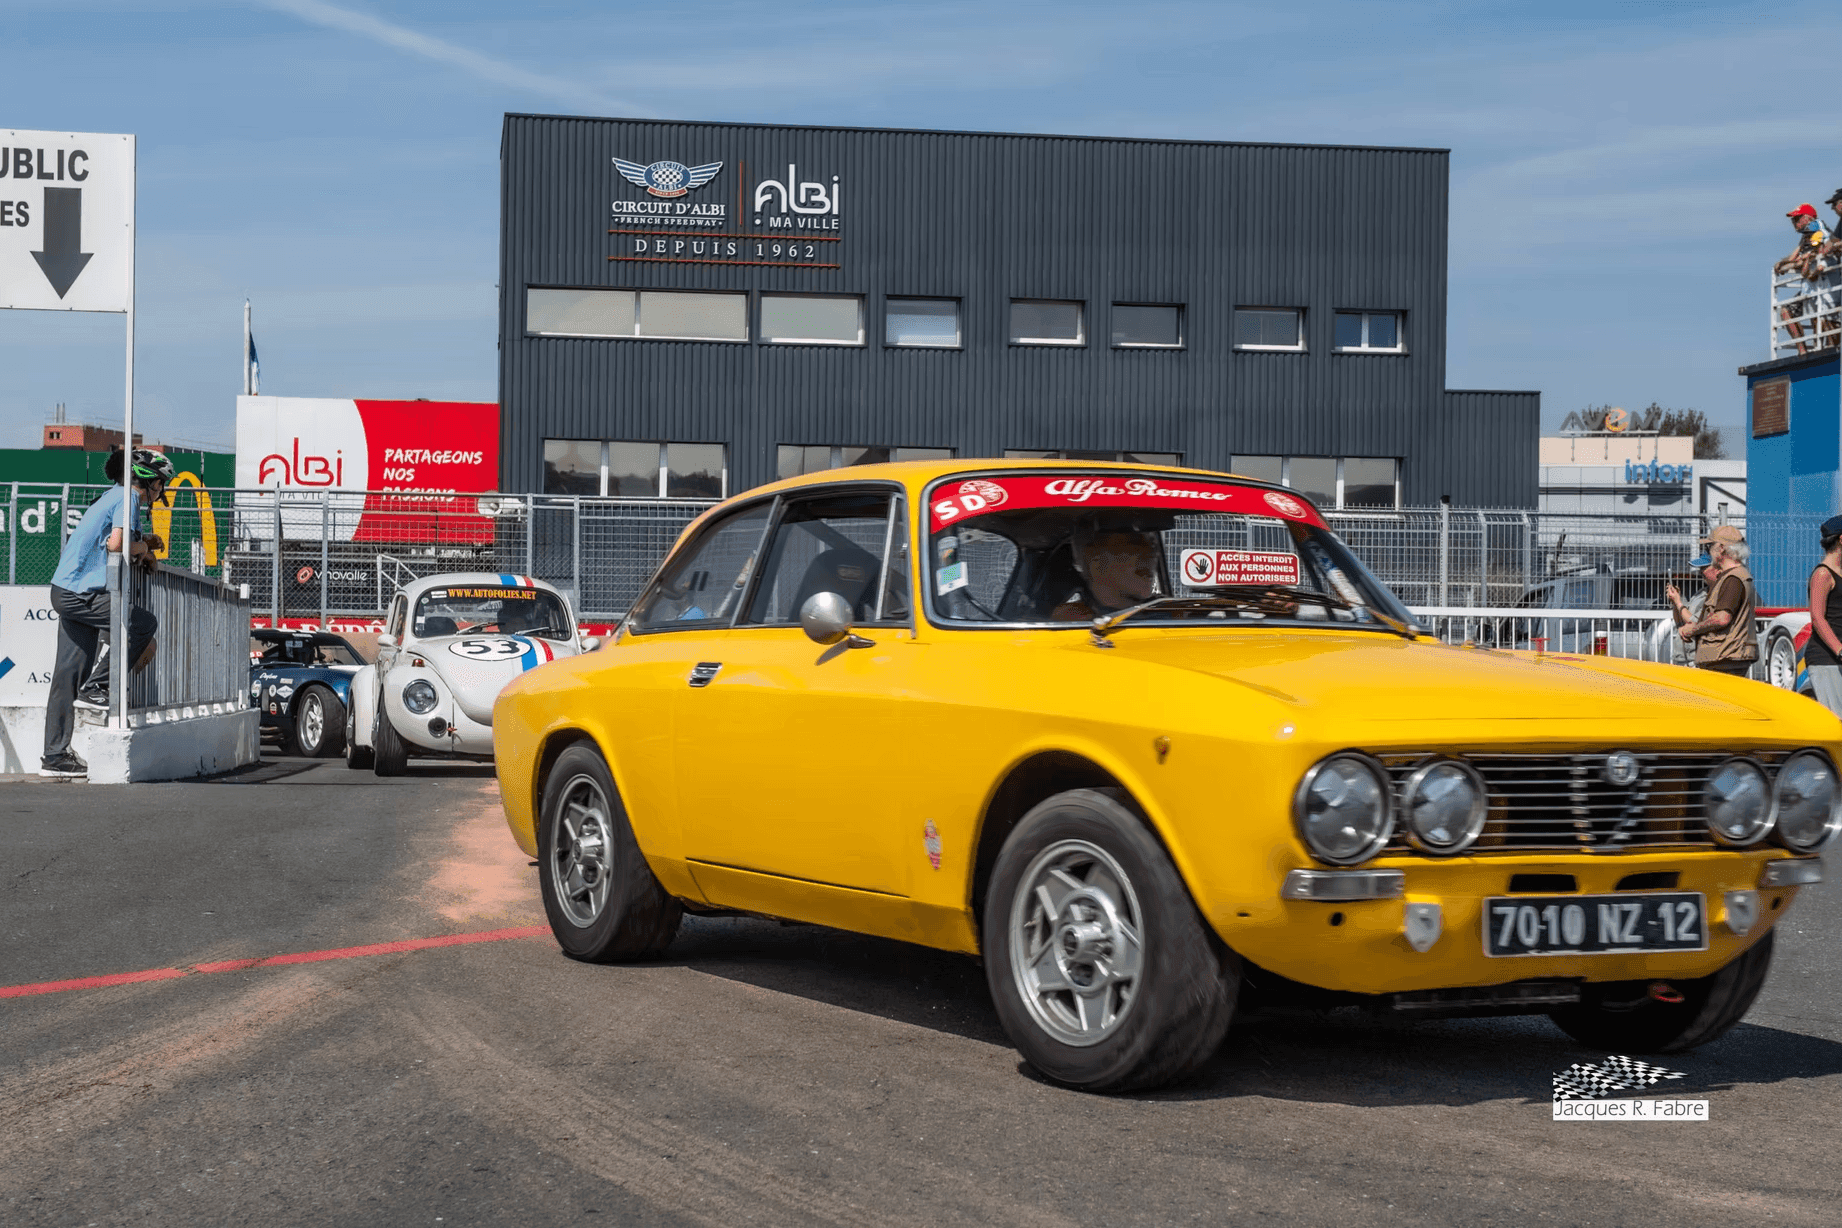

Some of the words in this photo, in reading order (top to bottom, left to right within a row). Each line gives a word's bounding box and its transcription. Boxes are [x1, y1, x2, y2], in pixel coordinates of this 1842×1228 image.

[0, 200, 30, 227] ES
[612, 201, 672, 214] CIRCUIT
[676, 203, 725, 216] D'ALBI
[664, 219, 717, 227] SPEEDWAY
[770, 217, 792, 228] MA
[797, 218, 839, 229] VILLE
[635, 239, 737, 255] DEPUIS
[756, 243, 814, 258] 1962
[384, 448, 483, 465] PARTAGEONS
[383, 467, 415, 482] NOS
[1625, 459, 1692, 481] infor
[1044, 479, 1125, 502] Alfa
[1124, 479, 1232, 501] Romeo
[1220, 553, 1251, 562] ACCES
[1253, 555, 1293, 565] INTERDIT
[315, 570, 368, 581] vnovalle
[1220, 563, 1239, 572] AUX
[1241, 564, 1294, 573] PERSONNES
[1218, 573, 1238, 582] NON
[1240, 573, 1296, 583] AUTORISEES
[447, 588, 537, 600] WWW.AUTOFOLIES.NET
[461, 640, 523, 655] 53
[1597, 903, 1644, 944] NZ
